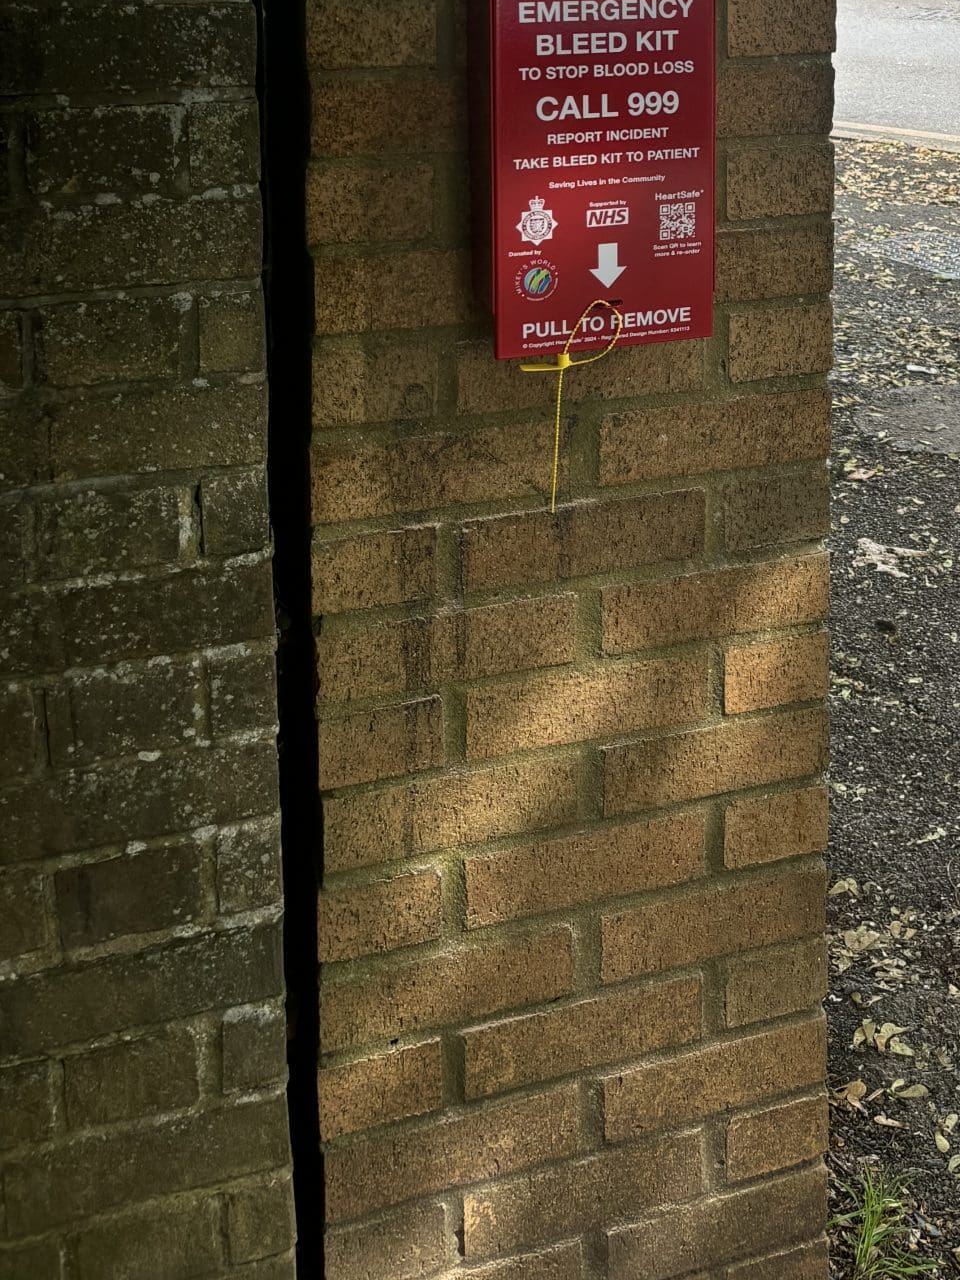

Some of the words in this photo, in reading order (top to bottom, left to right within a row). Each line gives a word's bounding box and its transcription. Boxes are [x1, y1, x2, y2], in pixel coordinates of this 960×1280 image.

[535, 31, 628, 56] BLEED
[635, 30, 680, 52] KIT
[519, 67, 542, 80] TO
[545, 65, 589, 80] STOP
[593, 62, 650, 78] BLOOD
[653, 60, 695, 75] LOSS
[535, 93, 619, 122] CALL
[627, 90, 680, 116] 999
[547, 131, 603, 145] REPORT
[606, 127, 669, 141] INCIDENT
[513, 157, 550, 170] TAKE
[552, 154, 598, 168] BLEED
[601, 152, 623, 164] KIT
[625, 150, 644, 163] TO
[647, 147, 701, 161] PATIENT
[548, 181, 575, 189] Saving
[577, 179, 597, 187] Lives
[608, 177, 620, 185] the
[622, 174, 666, 183] Community
[588, 209, 627, 225] NHS
[522, 319, 573, 339] PULL
[580, 316, 605, 332] TO
[610, 306, 692, 330] REMOVE
